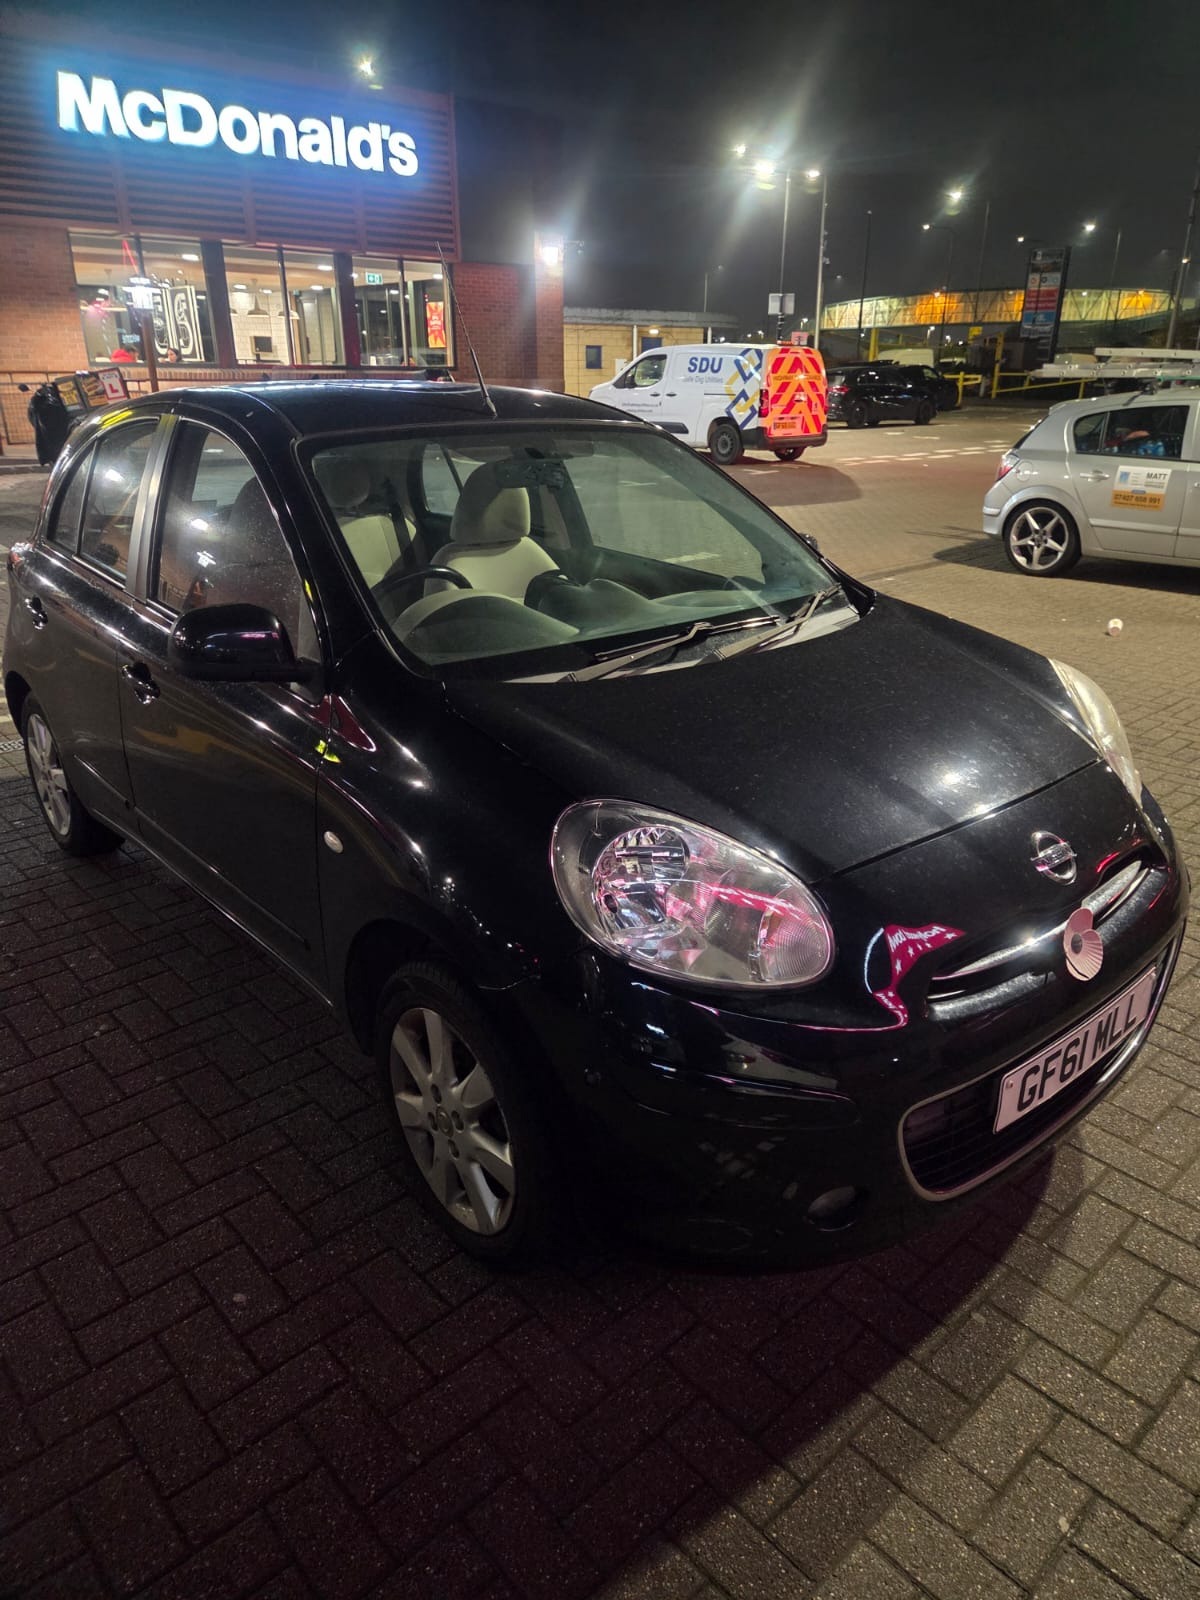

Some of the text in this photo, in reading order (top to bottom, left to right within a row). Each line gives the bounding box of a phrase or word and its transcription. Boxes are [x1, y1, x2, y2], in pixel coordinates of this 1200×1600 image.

[57, 70, 419, 177] McDonald's
[687, 356, 723, 374] SDU
[1017, 993, 1137, 1113] GF61 MLL
